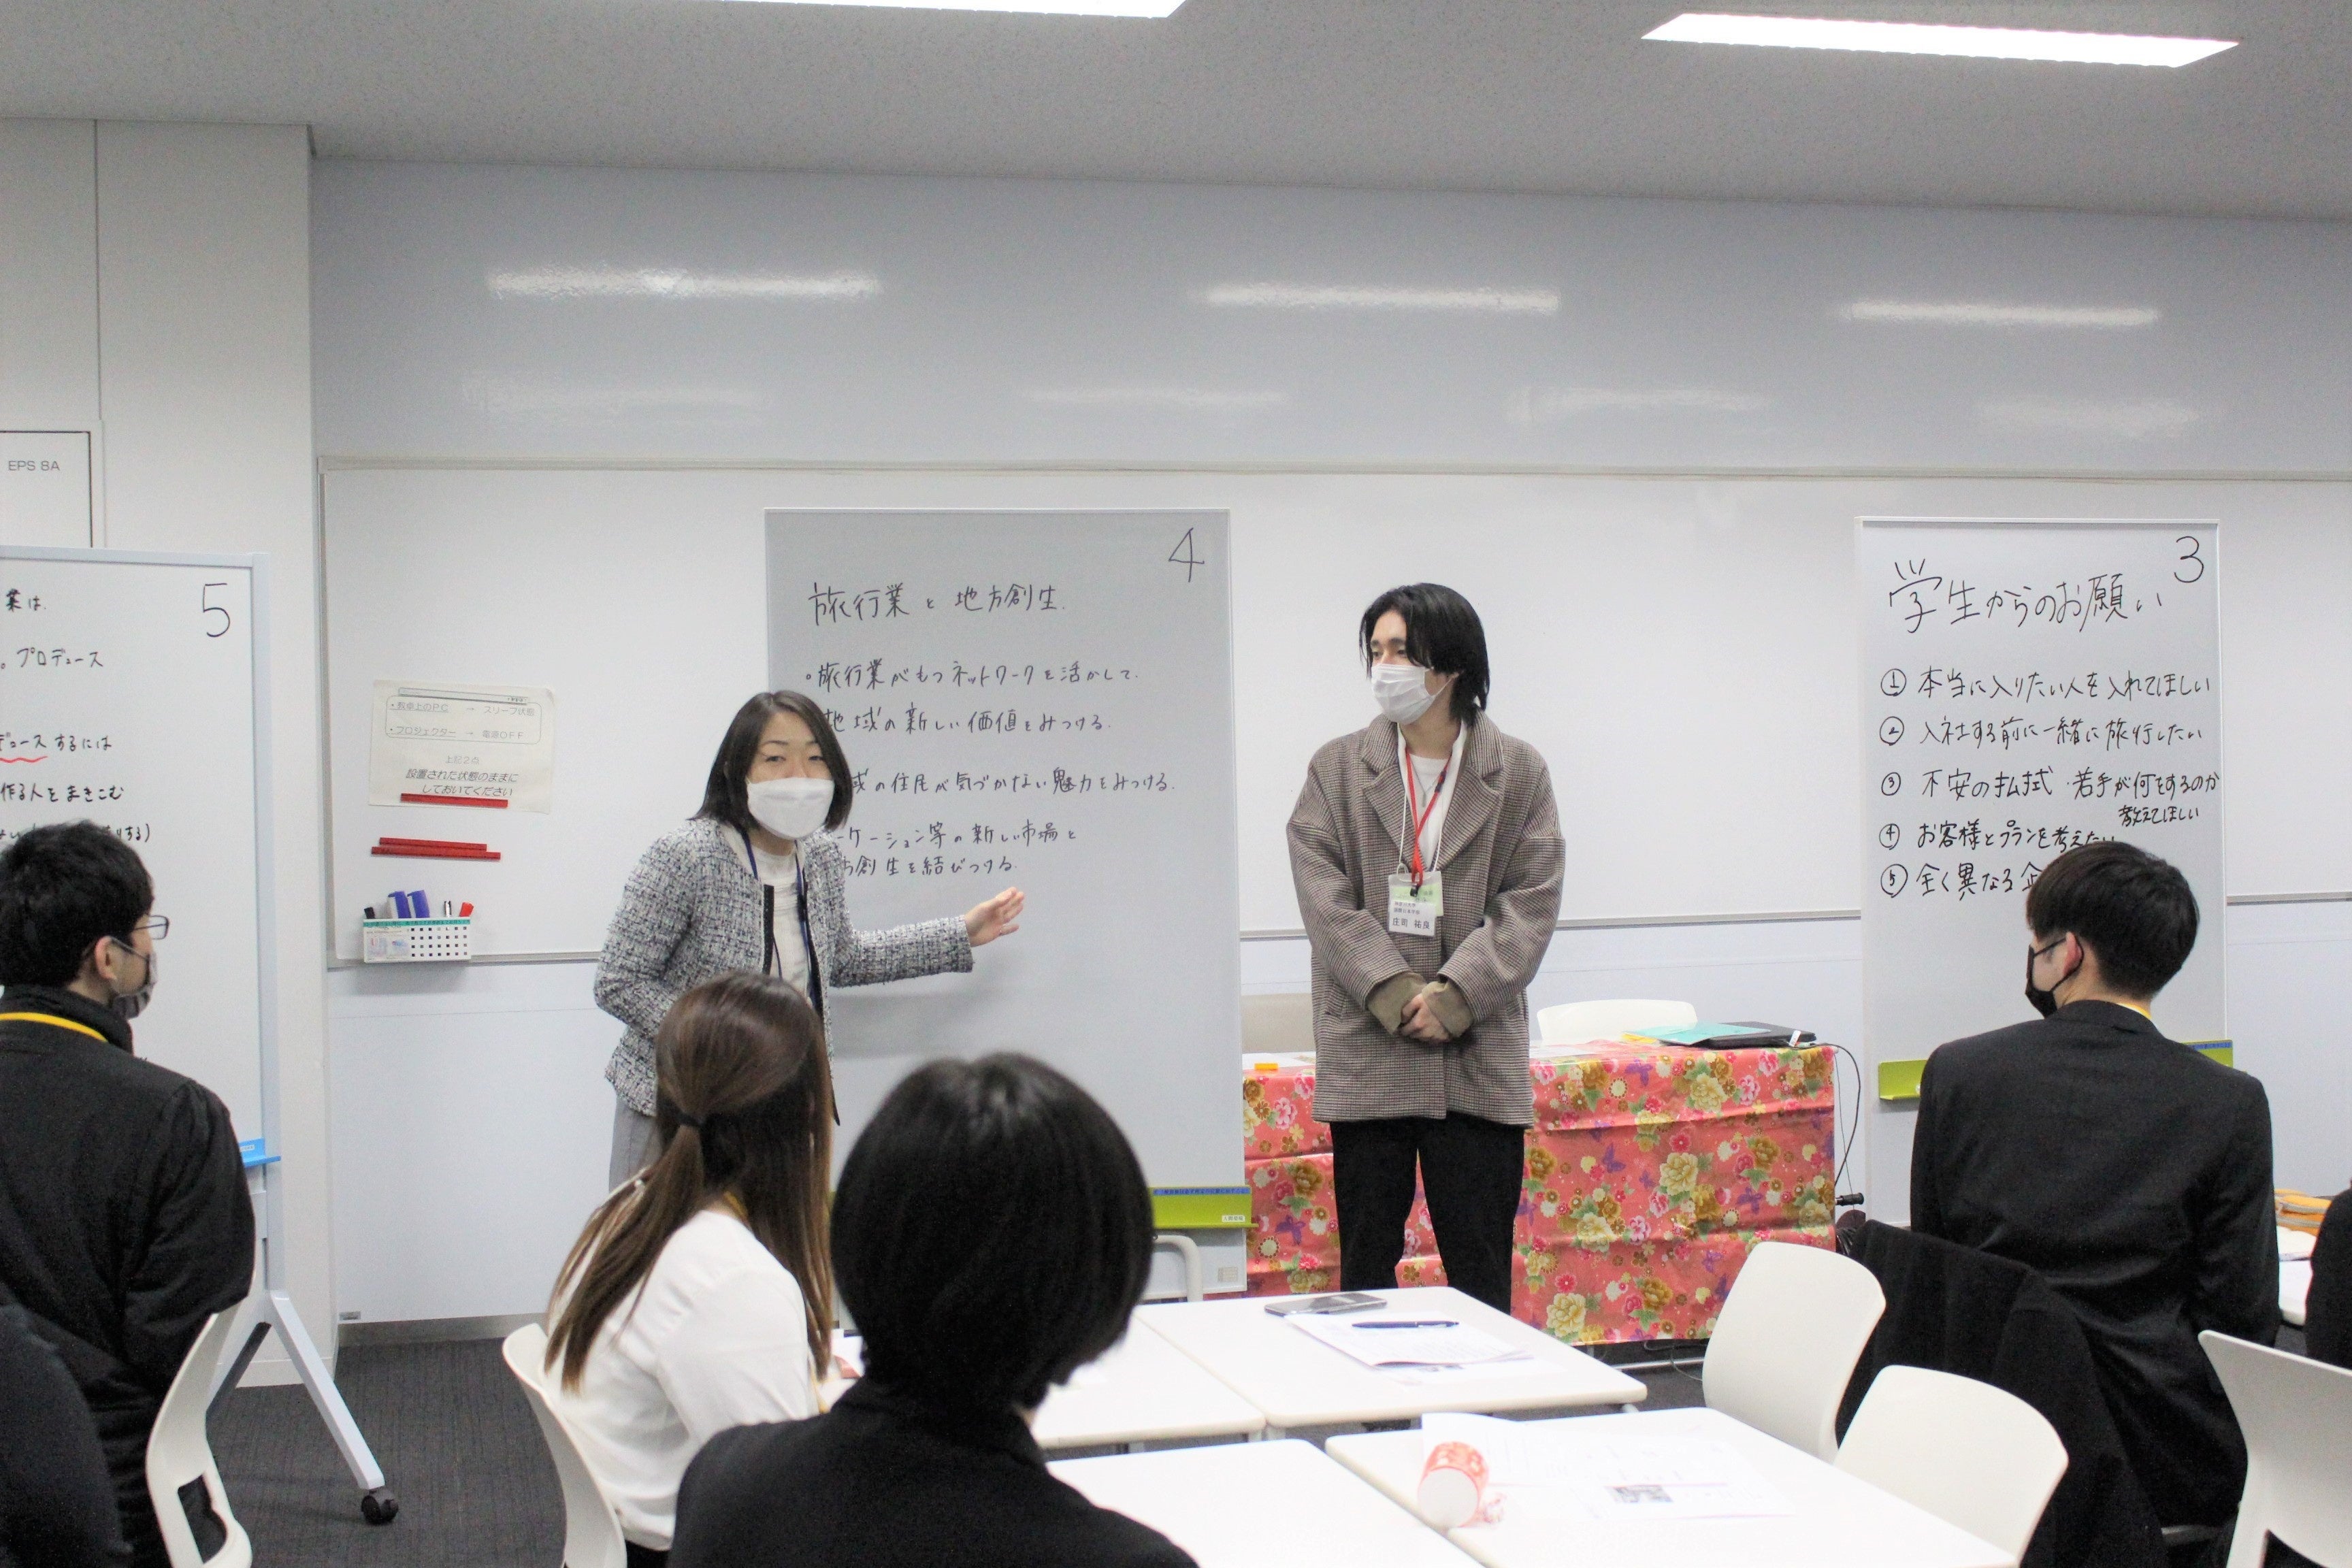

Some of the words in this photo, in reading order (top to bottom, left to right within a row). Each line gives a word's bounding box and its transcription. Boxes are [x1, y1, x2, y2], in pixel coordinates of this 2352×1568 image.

[8, 460, 35, 472] EPS
[41, 460, 61, 472] 8A
[1169, 527, 1205, 583] 4
[2173, 535, 2205, 584] 3
[202, 583, 231, 638] 5
[1889, 558, 2163, 634] 学生からのお願い
[1917, 665, 2210, 704] 本当に入りたい人を入れてほしい
[1920, 715, 2202, 751] 入社する前に一緒に旅行したい
[406, 768, 519, 783] 設置された状態のままに
[422, 783, 513, 797] しておいてください
[2118, 804, 2200, 828] 教えてほしい
